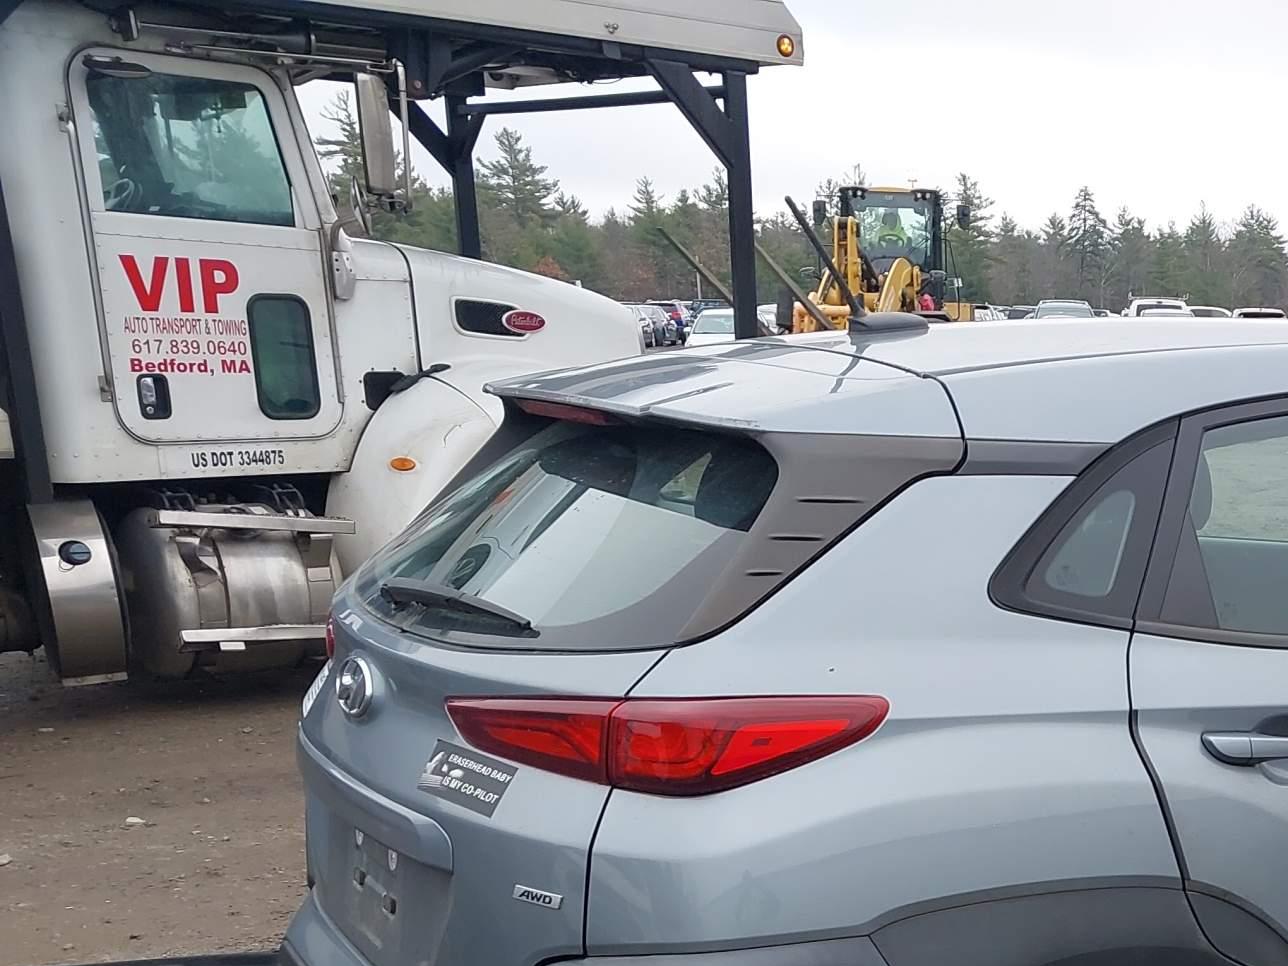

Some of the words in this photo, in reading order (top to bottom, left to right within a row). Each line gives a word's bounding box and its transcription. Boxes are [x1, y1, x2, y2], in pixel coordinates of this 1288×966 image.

[118, 254, 239, 313] VIP
[124, 317, 148, 334] AUTO
[149, 317, 202, 335] TRANSPORT
[205, 319, 212, 335] &
[212, 319, 247, 336] TOWING
[131, 339, 247, 355] 617.839.0640
[130, 358, 214, 376] Bedford,
[221, 359, 251, 374] MA
[191, 452, 208, 468] US
[211, 451, 234, 467] DOT
[238, 450, 285, 466] 3344875
[448, 753, 492, 776] ERASERHEAD
[490, 769, 512, 783] BABY
[442, 775, 451, 786] IS
[449, 778, 463, 790] MY
[461, 783, 499, 804] CO-PILOT
[518, 889, 553, 905] AWD
